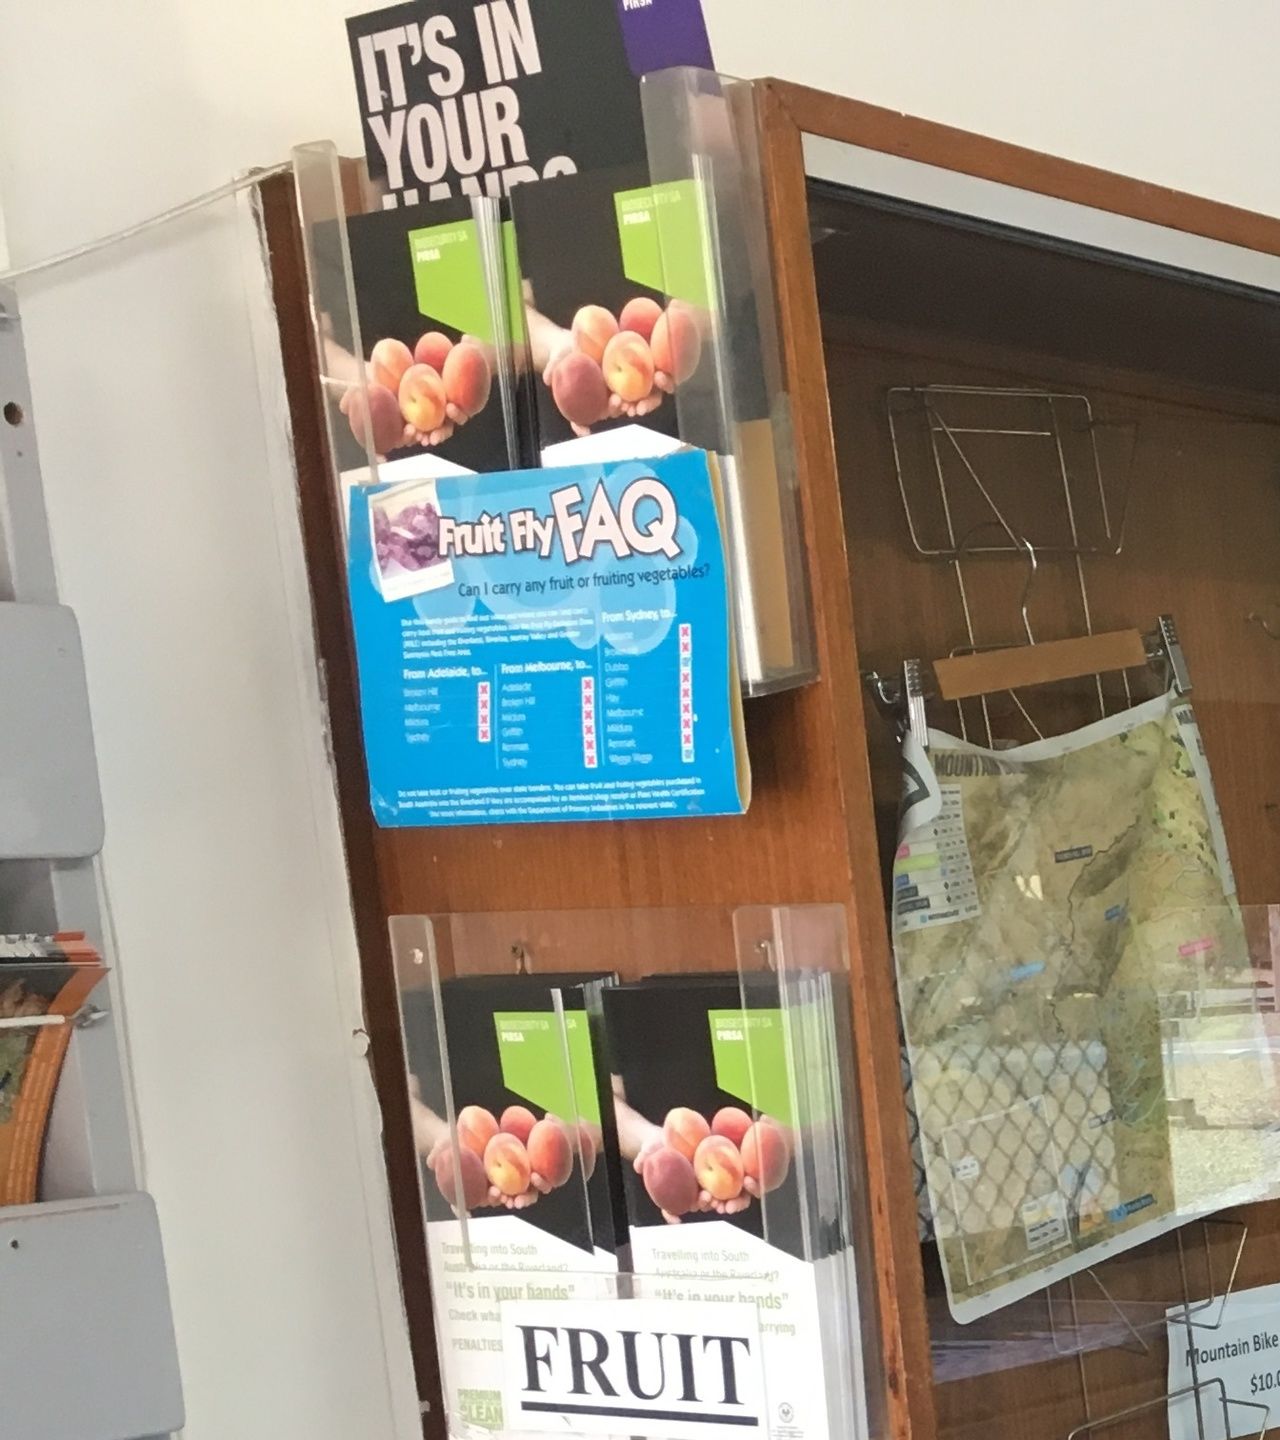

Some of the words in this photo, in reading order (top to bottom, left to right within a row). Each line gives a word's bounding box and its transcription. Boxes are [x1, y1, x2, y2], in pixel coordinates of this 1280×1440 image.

[358, 15, 465, 113] IT'S
[473, 0, 542, 85] IN
[367, 85, 530, 189] YOUR
[438, 510, 506, 558] Fruit
[508, 507, 554, 559] Fly
[551, 476, 684, 566] FAQ
[458, 583, 480, 597] Can
[492, 580, 521, 597] carry
[525, 576, 546, 593] any
[550, 574, 574, 590] fruit
[577, 575, 590, 588] or
[593, 569, 635, 588] fruiting
[638, 563, 710, 584] vegetables?
[602, 612, 624, 624] From
[717, 1030, 744, 1041] PIRSA
[510, 1242, 538, 1256] South
[652, 1248, 700, 1264] Travelling
[721, 1249, 750, 1263] South
[477, 1283, 490, 1299] in
[449, 1308, 478, 1322] Check
[480, 1308, 502, 1322] wha
[757, 1322, 796, 1337] arrying
[452, 1338, 503, 1352] PENALTIES
[1186, 1337, 1250, 1367] Mountain
[1253, 1331, 1279, 1352] Bike
[515, 1325, 751, 1405] FRUIT
